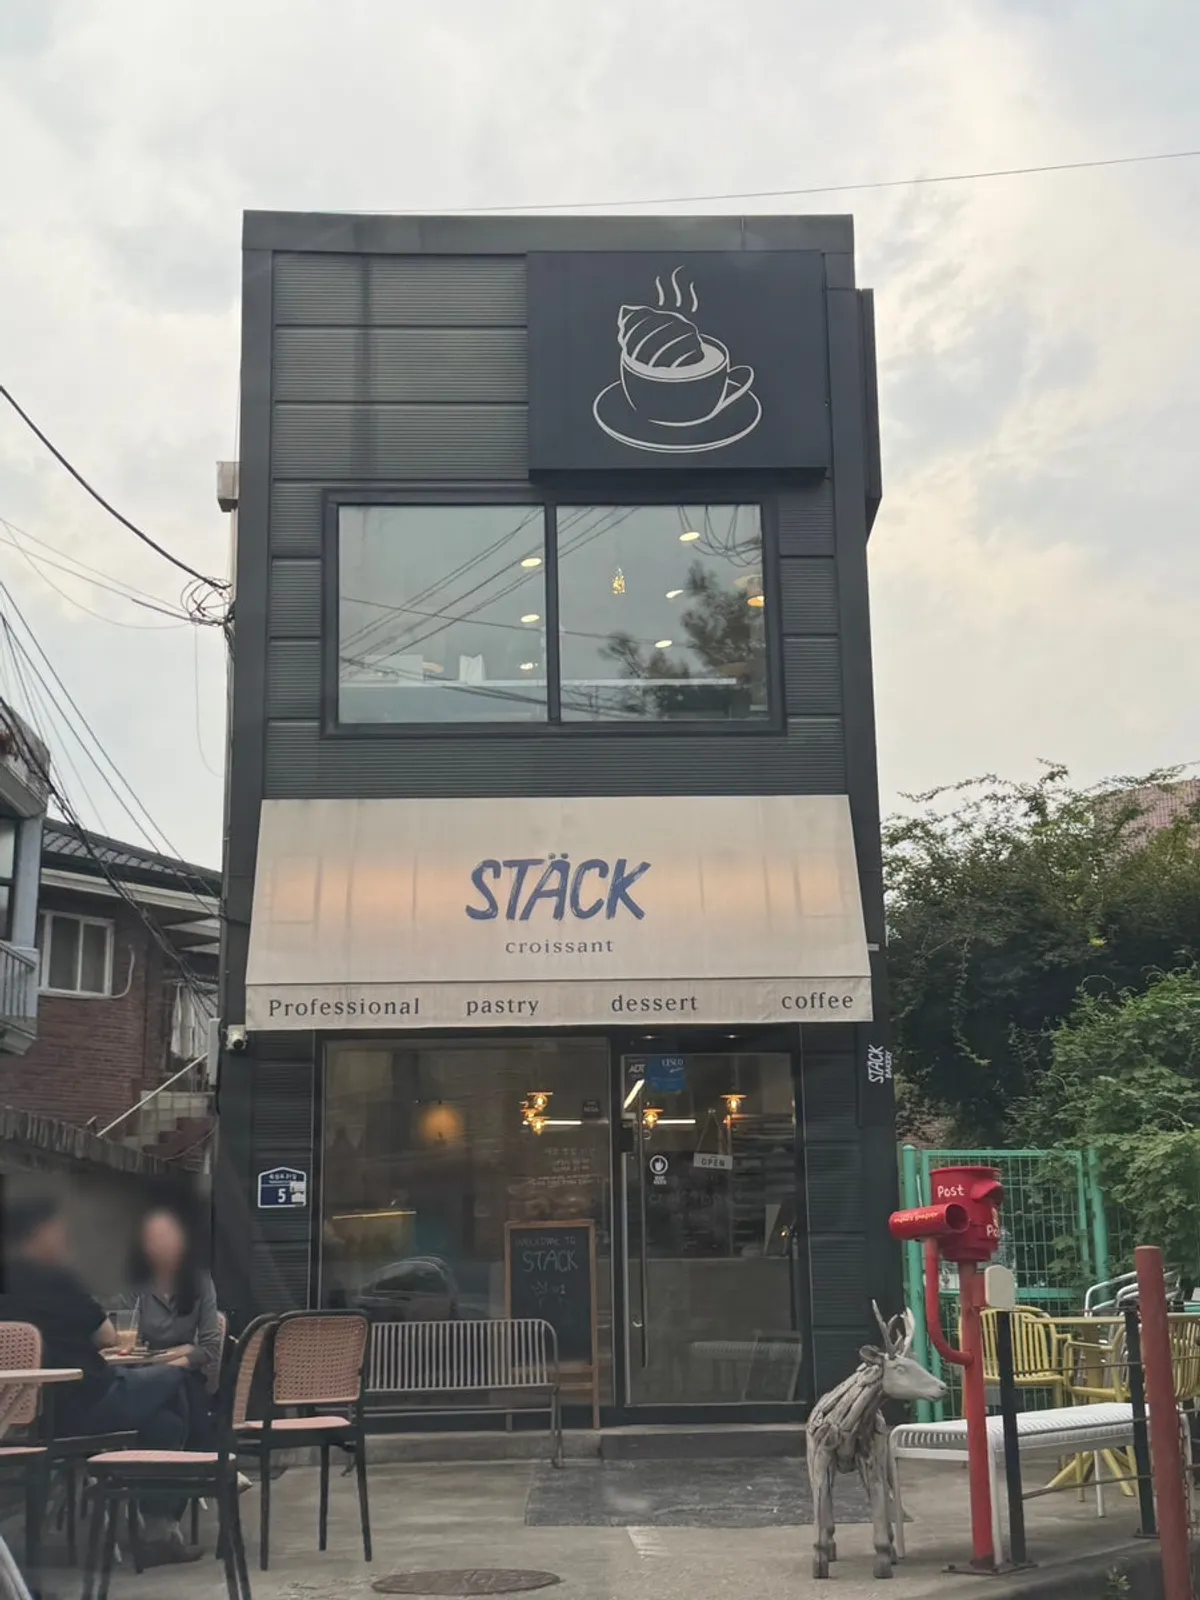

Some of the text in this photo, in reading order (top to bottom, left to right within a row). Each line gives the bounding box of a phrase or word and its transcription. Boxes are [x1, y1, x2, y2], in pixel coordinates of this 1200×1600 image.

[505, 939, 615, 954] croissant
[268, 991, 854, 1018] Professional pastry dessert coffee
[701, 1157, 725, 1167] OPEN
[277, 1188, 286, 1203] 5
[937, 1184, 964, 1198] Post
[522, 1250, 579, 1273] STACK
